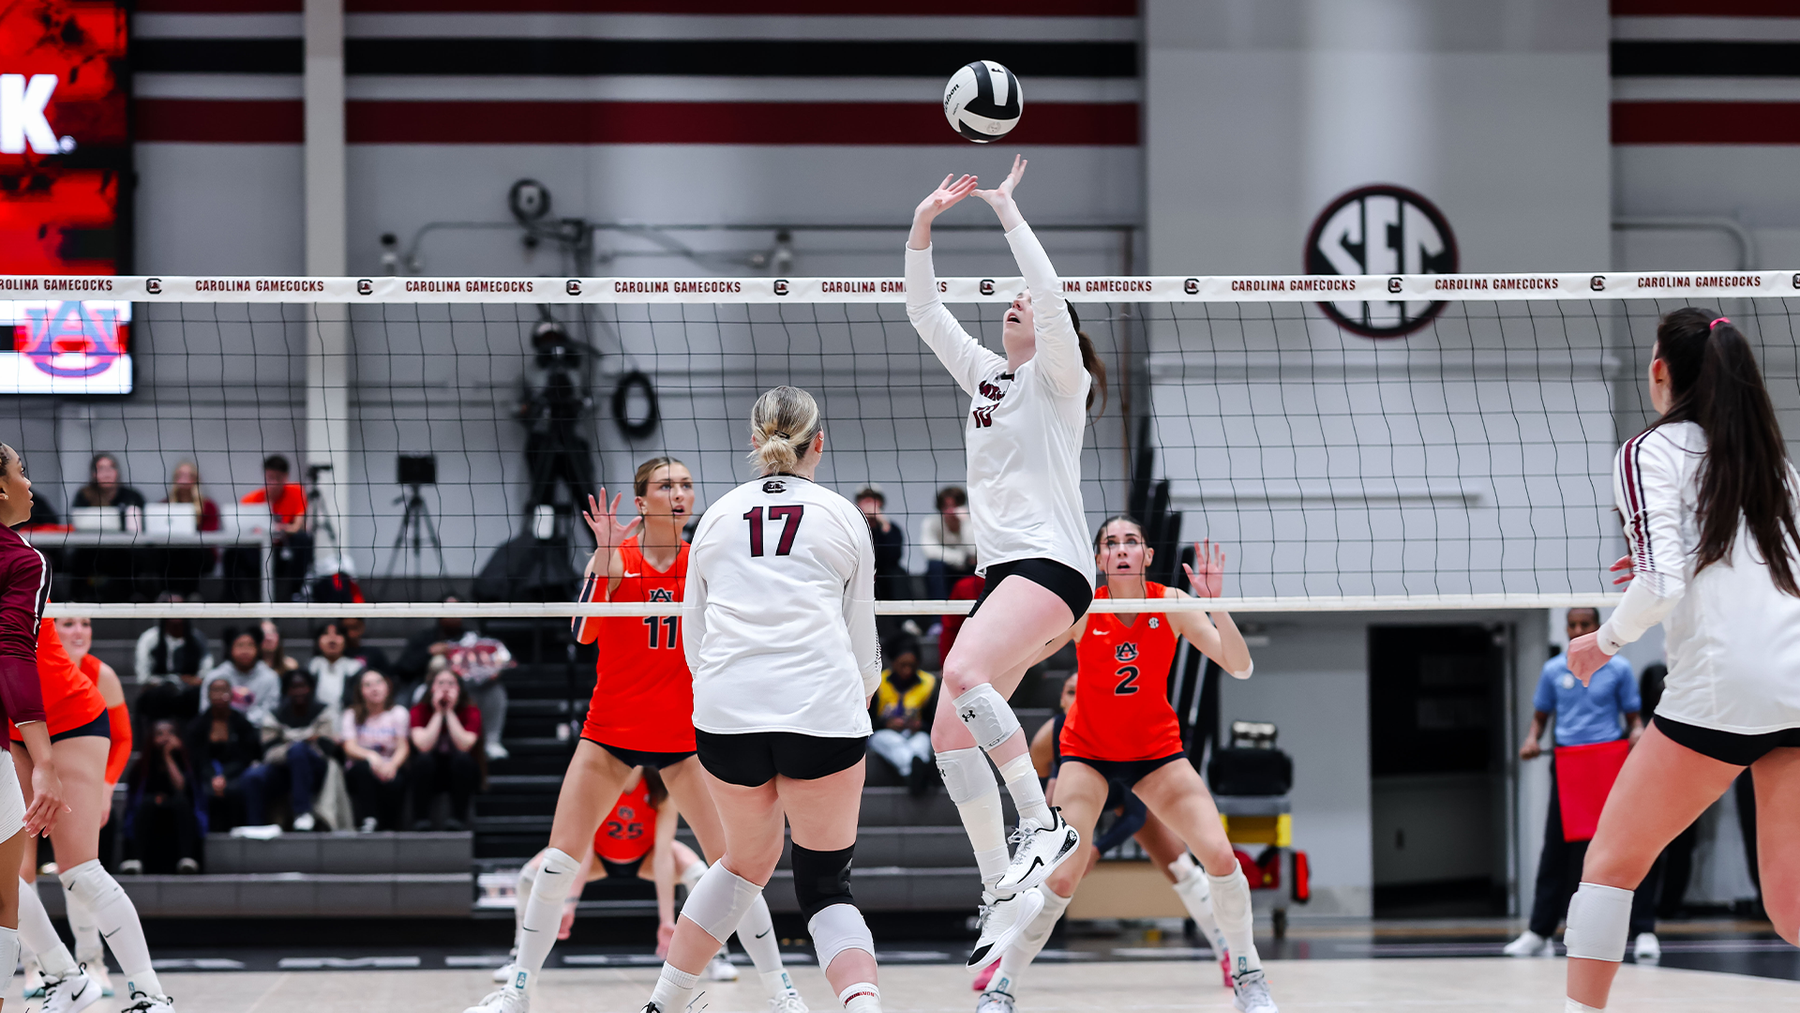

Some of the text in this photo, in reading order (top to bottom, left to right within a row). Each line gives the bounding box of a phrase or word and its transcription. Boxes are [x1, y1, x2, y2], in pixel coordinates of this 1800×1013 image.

[1317, 194, 1445, 328] SEC
[43, 278, 113, 292] GAMECOCKS
[195, 279, 324, 292] CAROLINA GAMECOCKS
[405, 280, 534, 293] CAROLINA GAMECOCKS
[614, 281, 741, 293] CAROLINA GAMECOCKS
[821, 281, 876, 293] CAROLINA
[1085, 280, 1152, 293] GAMECOCKS
[1231, 279, 1356, 292] CAROLINA GAMECOCKS
[1434, 278, 1559, 291] CAROLINA GAMECOCKS
[1637, 275, 1761, 289] CAROLINA GAMECOCKS
[973, 403, 1000, 428] 10
[743, 504, 804, 557] 17
[643, 616, 678, 649] 11
[1115, 664, 1140, 696] 2
[606, 821, 644, 840] 25
